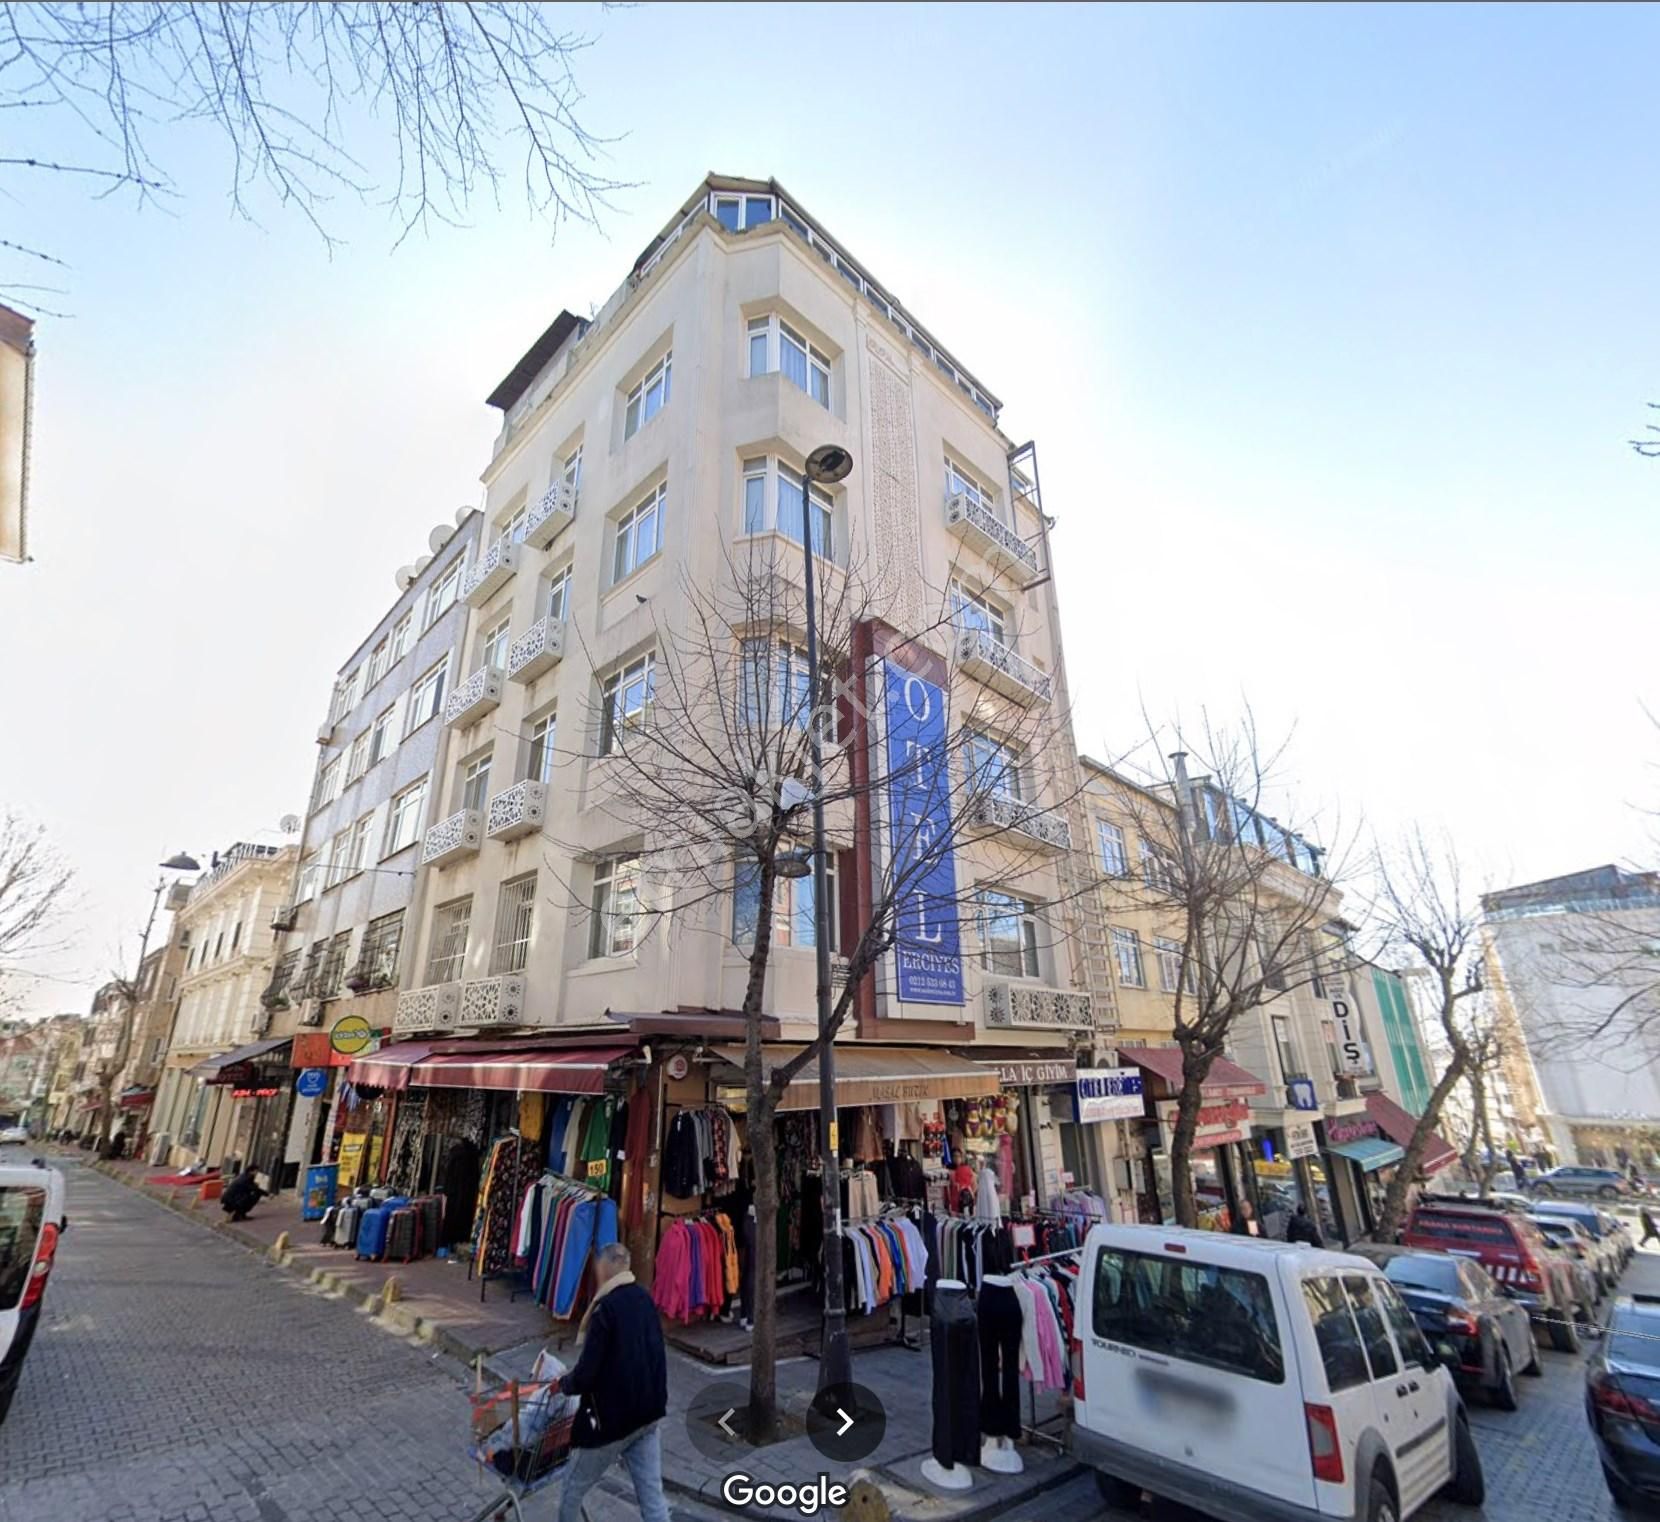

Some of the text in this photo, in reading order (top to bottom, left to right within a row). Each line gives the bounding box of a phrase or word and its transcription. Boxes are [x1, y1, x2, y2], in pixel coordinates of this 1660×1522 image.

[903, 677, 943, 945] OTEL
[1332, 1001, 1360, 1065] DİŞ
[1036, 1064, 1068, 1081] GİYİM
[590, 1162, 604, 1175] 150
